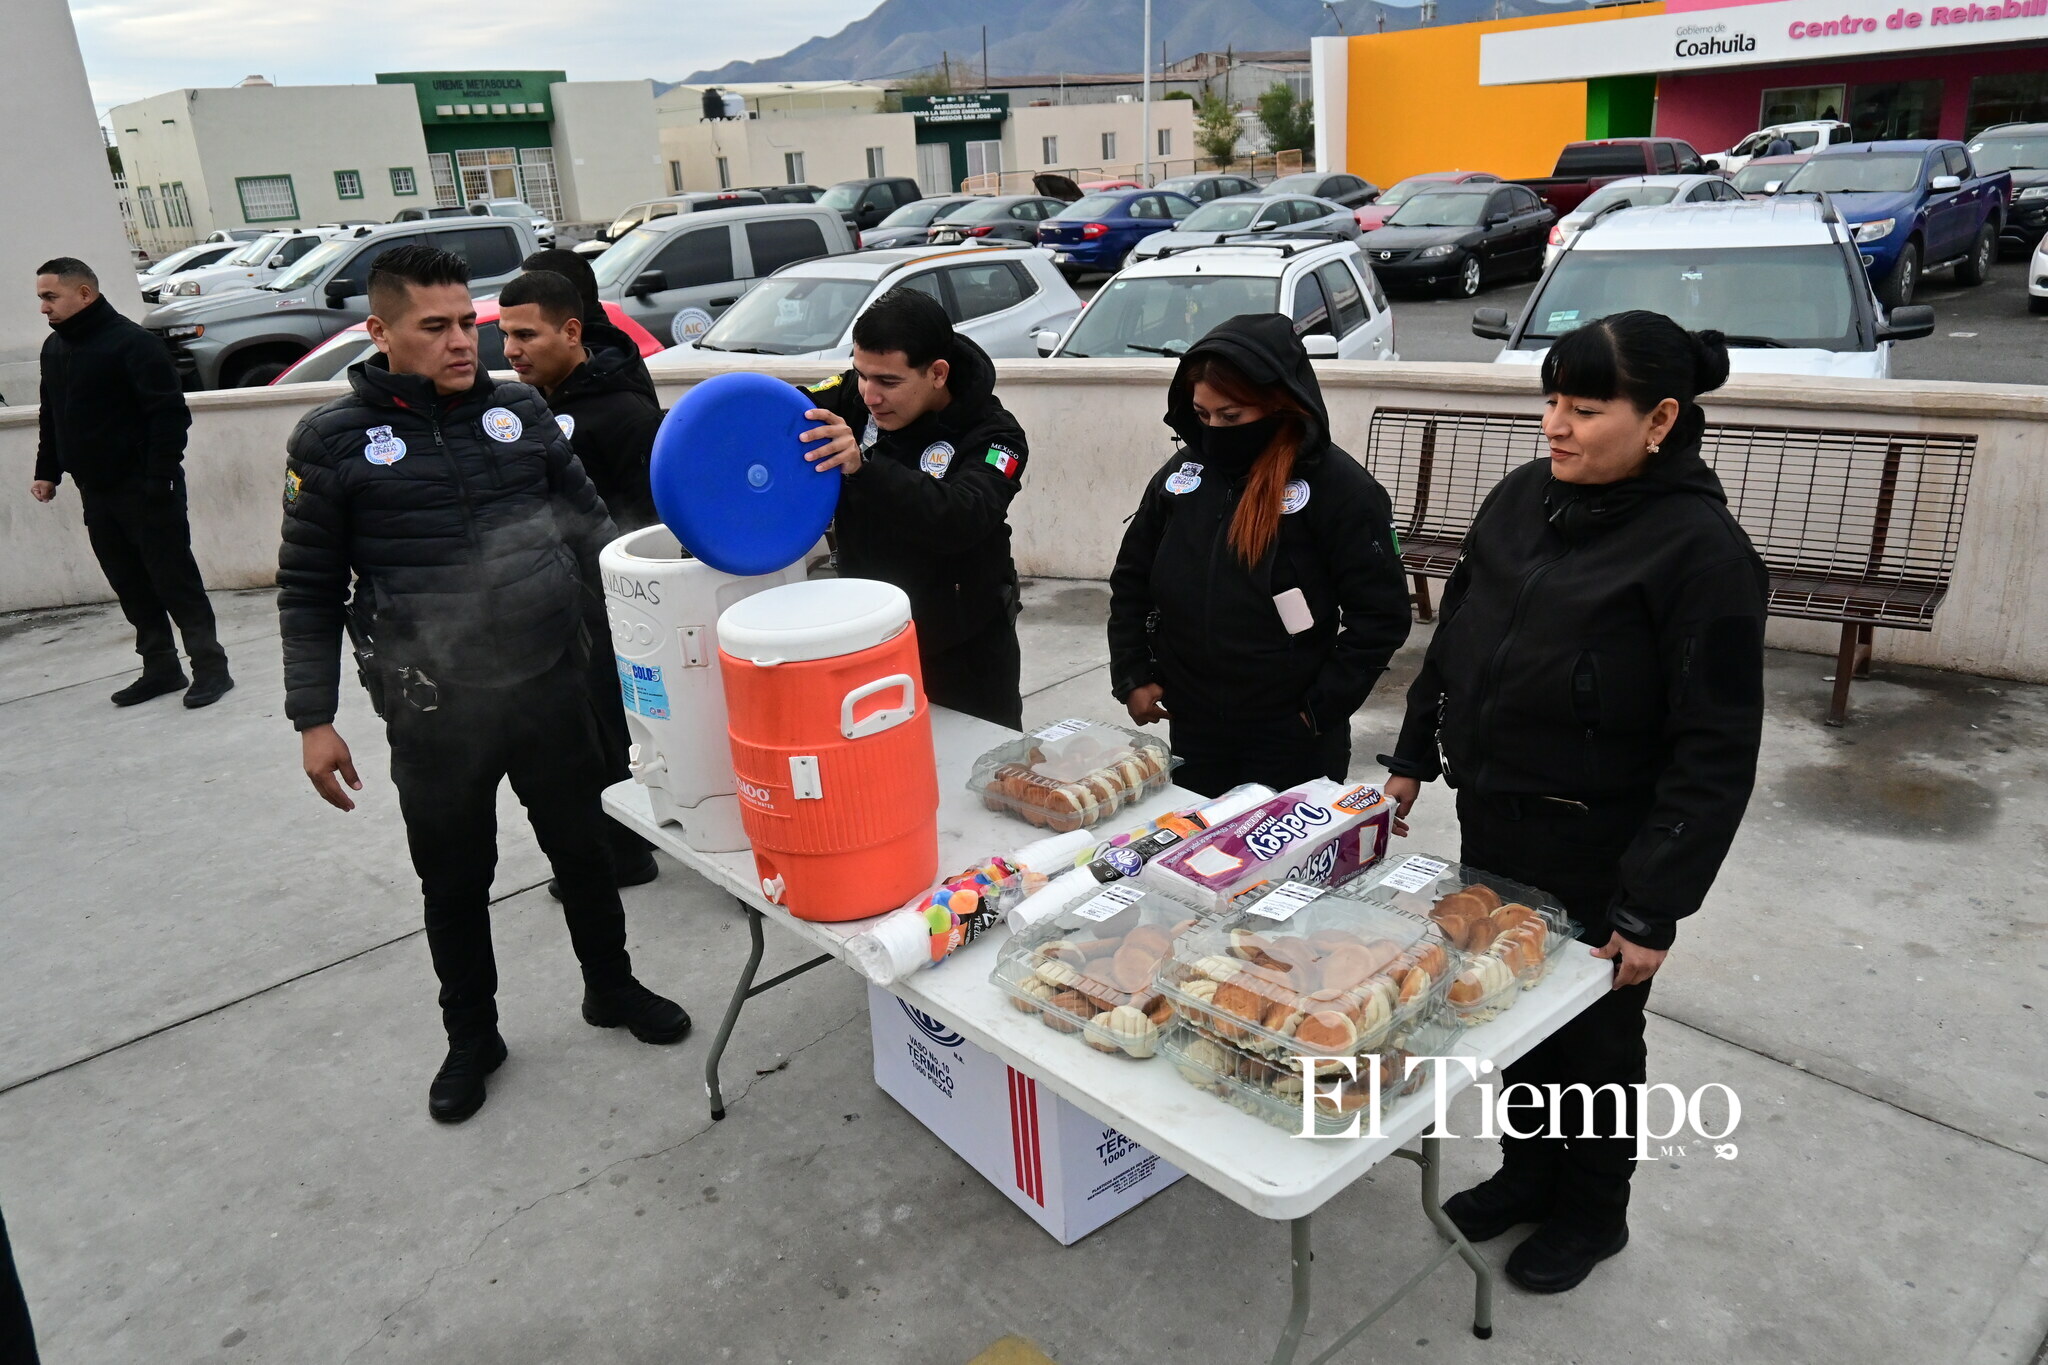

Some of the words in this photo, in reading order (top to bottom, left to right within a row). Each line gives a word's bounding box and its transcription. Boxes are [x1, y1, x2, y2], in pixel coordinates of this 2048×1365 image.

[1676, 24, 1714, 36] Gobierno
[1715, 23, 1726, 33] de
[1788, 14, 1878, 40] Centro
[1886, 8, 1923, 30] de
[1675, 34, 1756, 57] Coahuila
[684, 322, 703, 335] AIC
[930, 453, 946, 464] AIC
[1245, 802, 1331, 861] Delsey
[1251, 815, 1278, 838] max
[908, 1034, 928, 1056] VASO
[929, 1051, 940, 1067] No.
[942, 1062, 950, 1074] 10
[907, 1042, 954, 1090] TERMICO
[912, 1060, 926, 1077] 1000
[928, 1072, 953, 1099] PIEZAS
[1102, 1127, 1119, 1140] VA
[1096, 1134, 1131, 1158] TER
[1103, 1148, 1126, 1167] 1000
